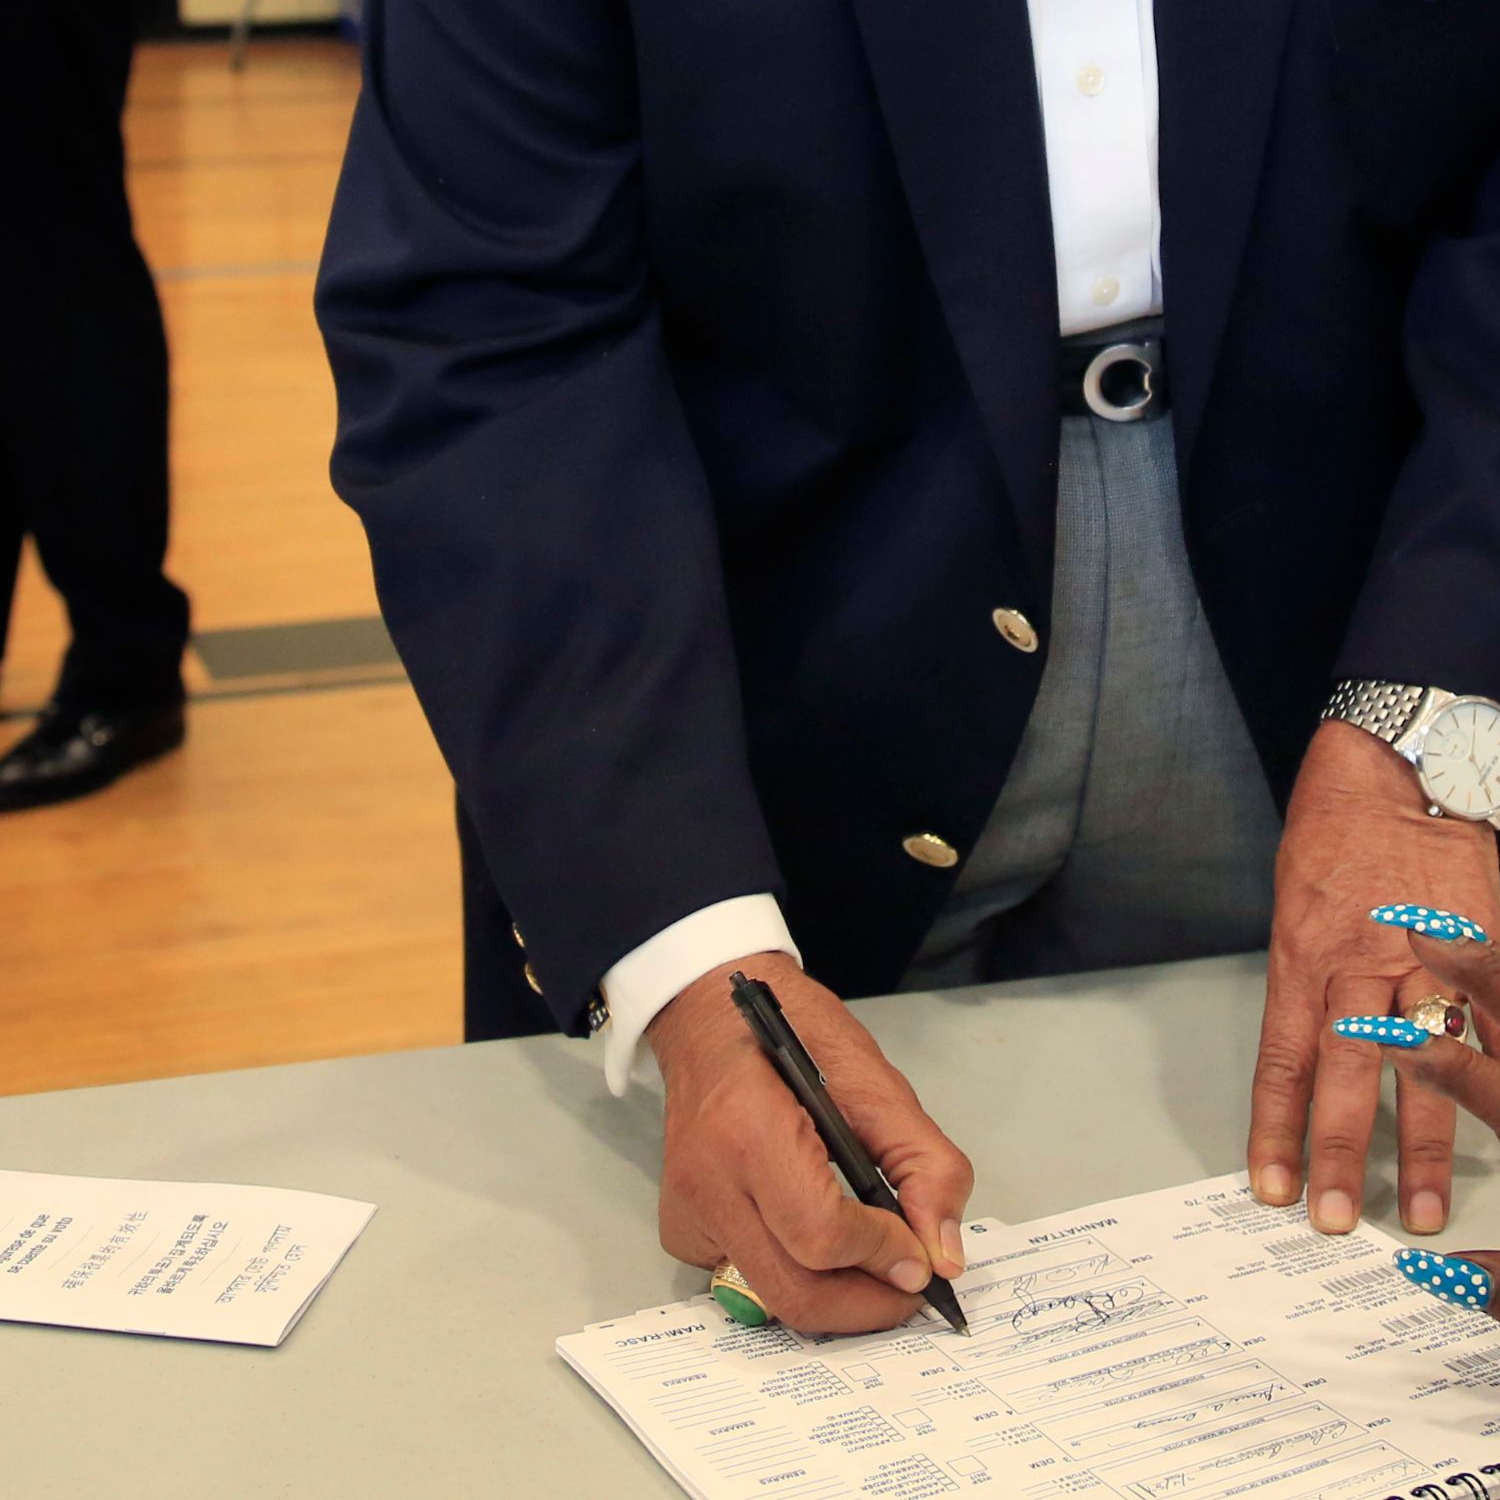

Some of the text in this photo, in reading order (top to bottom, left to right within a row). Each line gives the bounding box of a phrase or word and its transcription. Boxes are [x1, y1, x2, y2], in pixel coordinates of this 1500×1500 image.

[51, 1217, 73, 1232] voto
[1028, 1218, 1118, 1245] MANHATTAN
[1185, 1294, 1208, 1305] DEM
[615, 1323, 706, 1348] RAMI-RASC
[1242, 1336, 1266, 1347] DEM
[762, 1370, 816, 1385] EMERGENCY
[920, 1366, 945, 1377] DEM
[662, 1372, 708, 1387] REMARKS
[759, 1376, 822, 1393] COURT ORDER
[1302, 1377, 1327, 1388] DEM
[769, 1380, 828, 1397] CHALLENGED
[791, 1386, 833, 1399] ASSISTED
[796, 1391, 839, 1405] AFFIDAVIT
[812, 1415, 868, 1432] EMERGENCY
[972, 1410, 999, 1422] DEM
[1366, 1417, 1391, 1429] DEM
[708, 1419, 756, 1436] REMARKS
[808, 1421, 874, 1440] COURT ORDER
[819, 1426, 880, 1444] CHALLENGED
[841, 1433, 884, 1446] ASSISTED
[847, 1438, 891, 1453] AFFIDAVIT
[1029, 1457, 1055, 1469] DEM
[1432, 1458, 1458, 1469] DEM
[759, 1469, 807, 1485] REMARKS
[860, 1470, 927, 1491] COURT ORDER
[863, 1464, 920, 1482] EMERGENCY
[871, 1475, 933, 1495] CHALLENGED
[894, 1481, 939, 1497] ASSISTED
